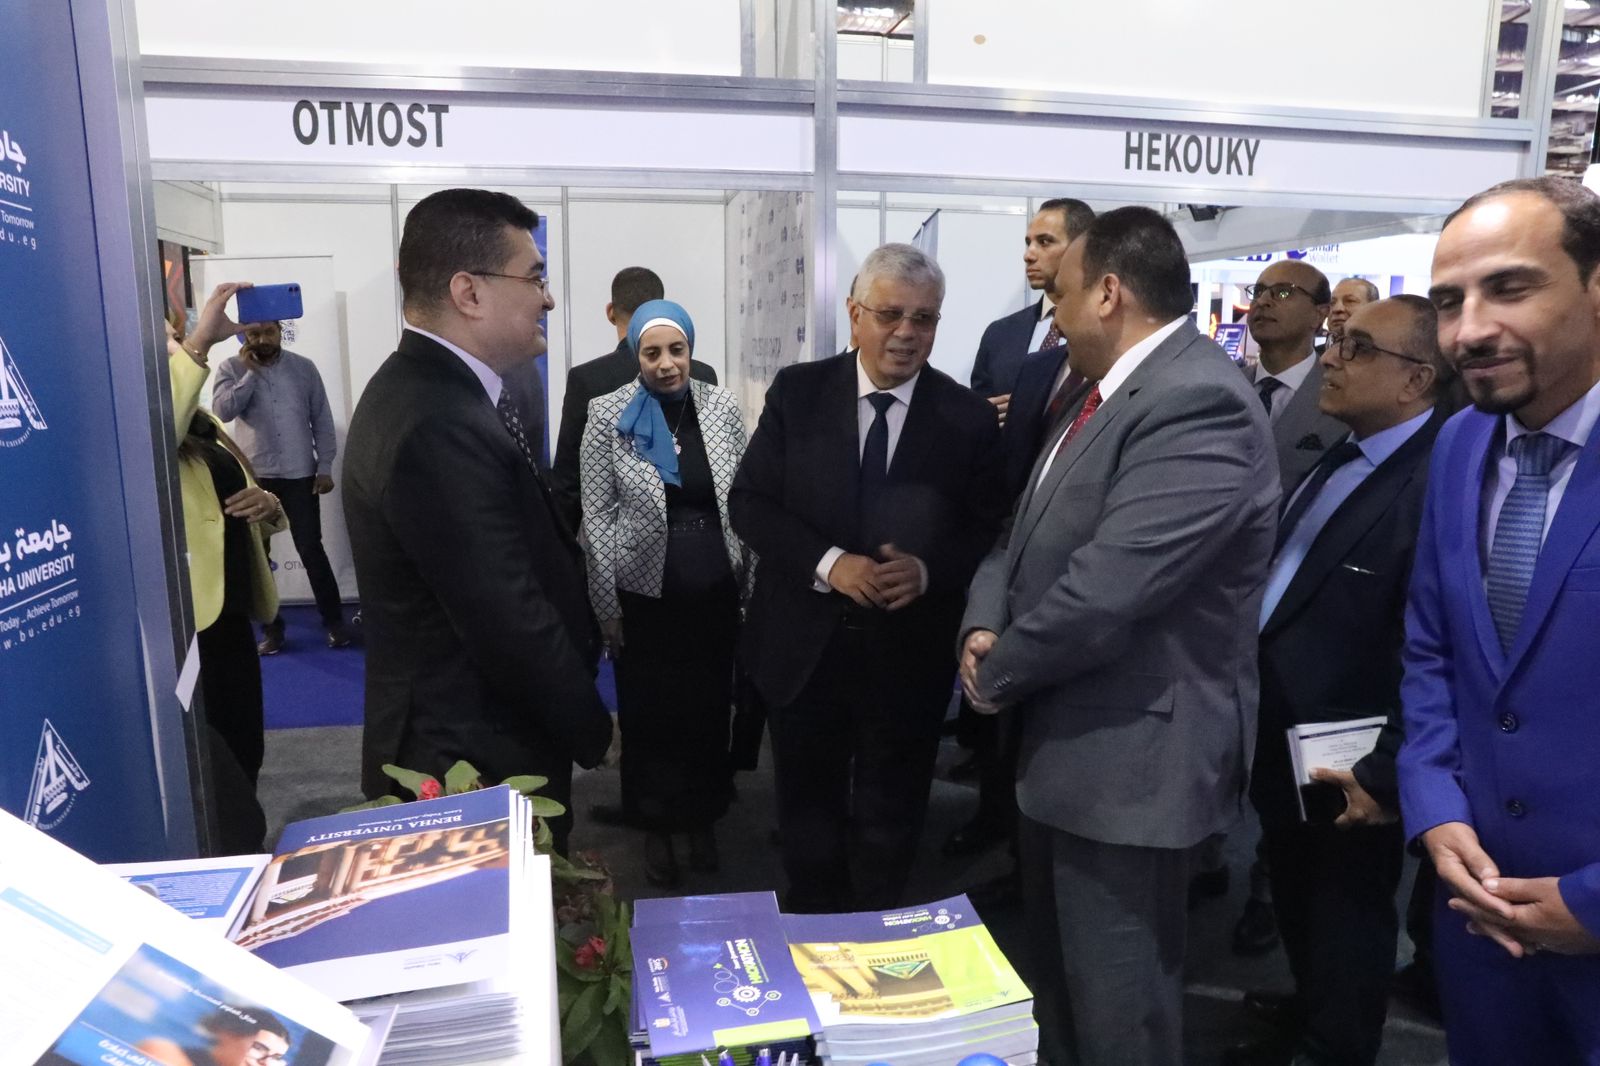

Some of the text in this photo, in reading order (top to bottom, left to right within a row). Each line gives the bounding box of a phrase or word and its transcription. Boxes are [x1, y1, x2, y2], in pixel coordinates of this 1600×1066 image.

[293, 99, 449, 148] OTMOST
[1125, 131, 1260, 176] HEKOUKY
[1, 210, 35, 231] Tomorrow
[15, 519, 72, 560] جامعة
[16, 553, 75, 591] UNIVERSITY
[26, 602, 51, 621] Achieve
[49, 590, 79, 609] Tomorrow
[306, 814, 463, 844] BENHA UNIVERSITY
[734, 938, 764, 985] HACKATHON
